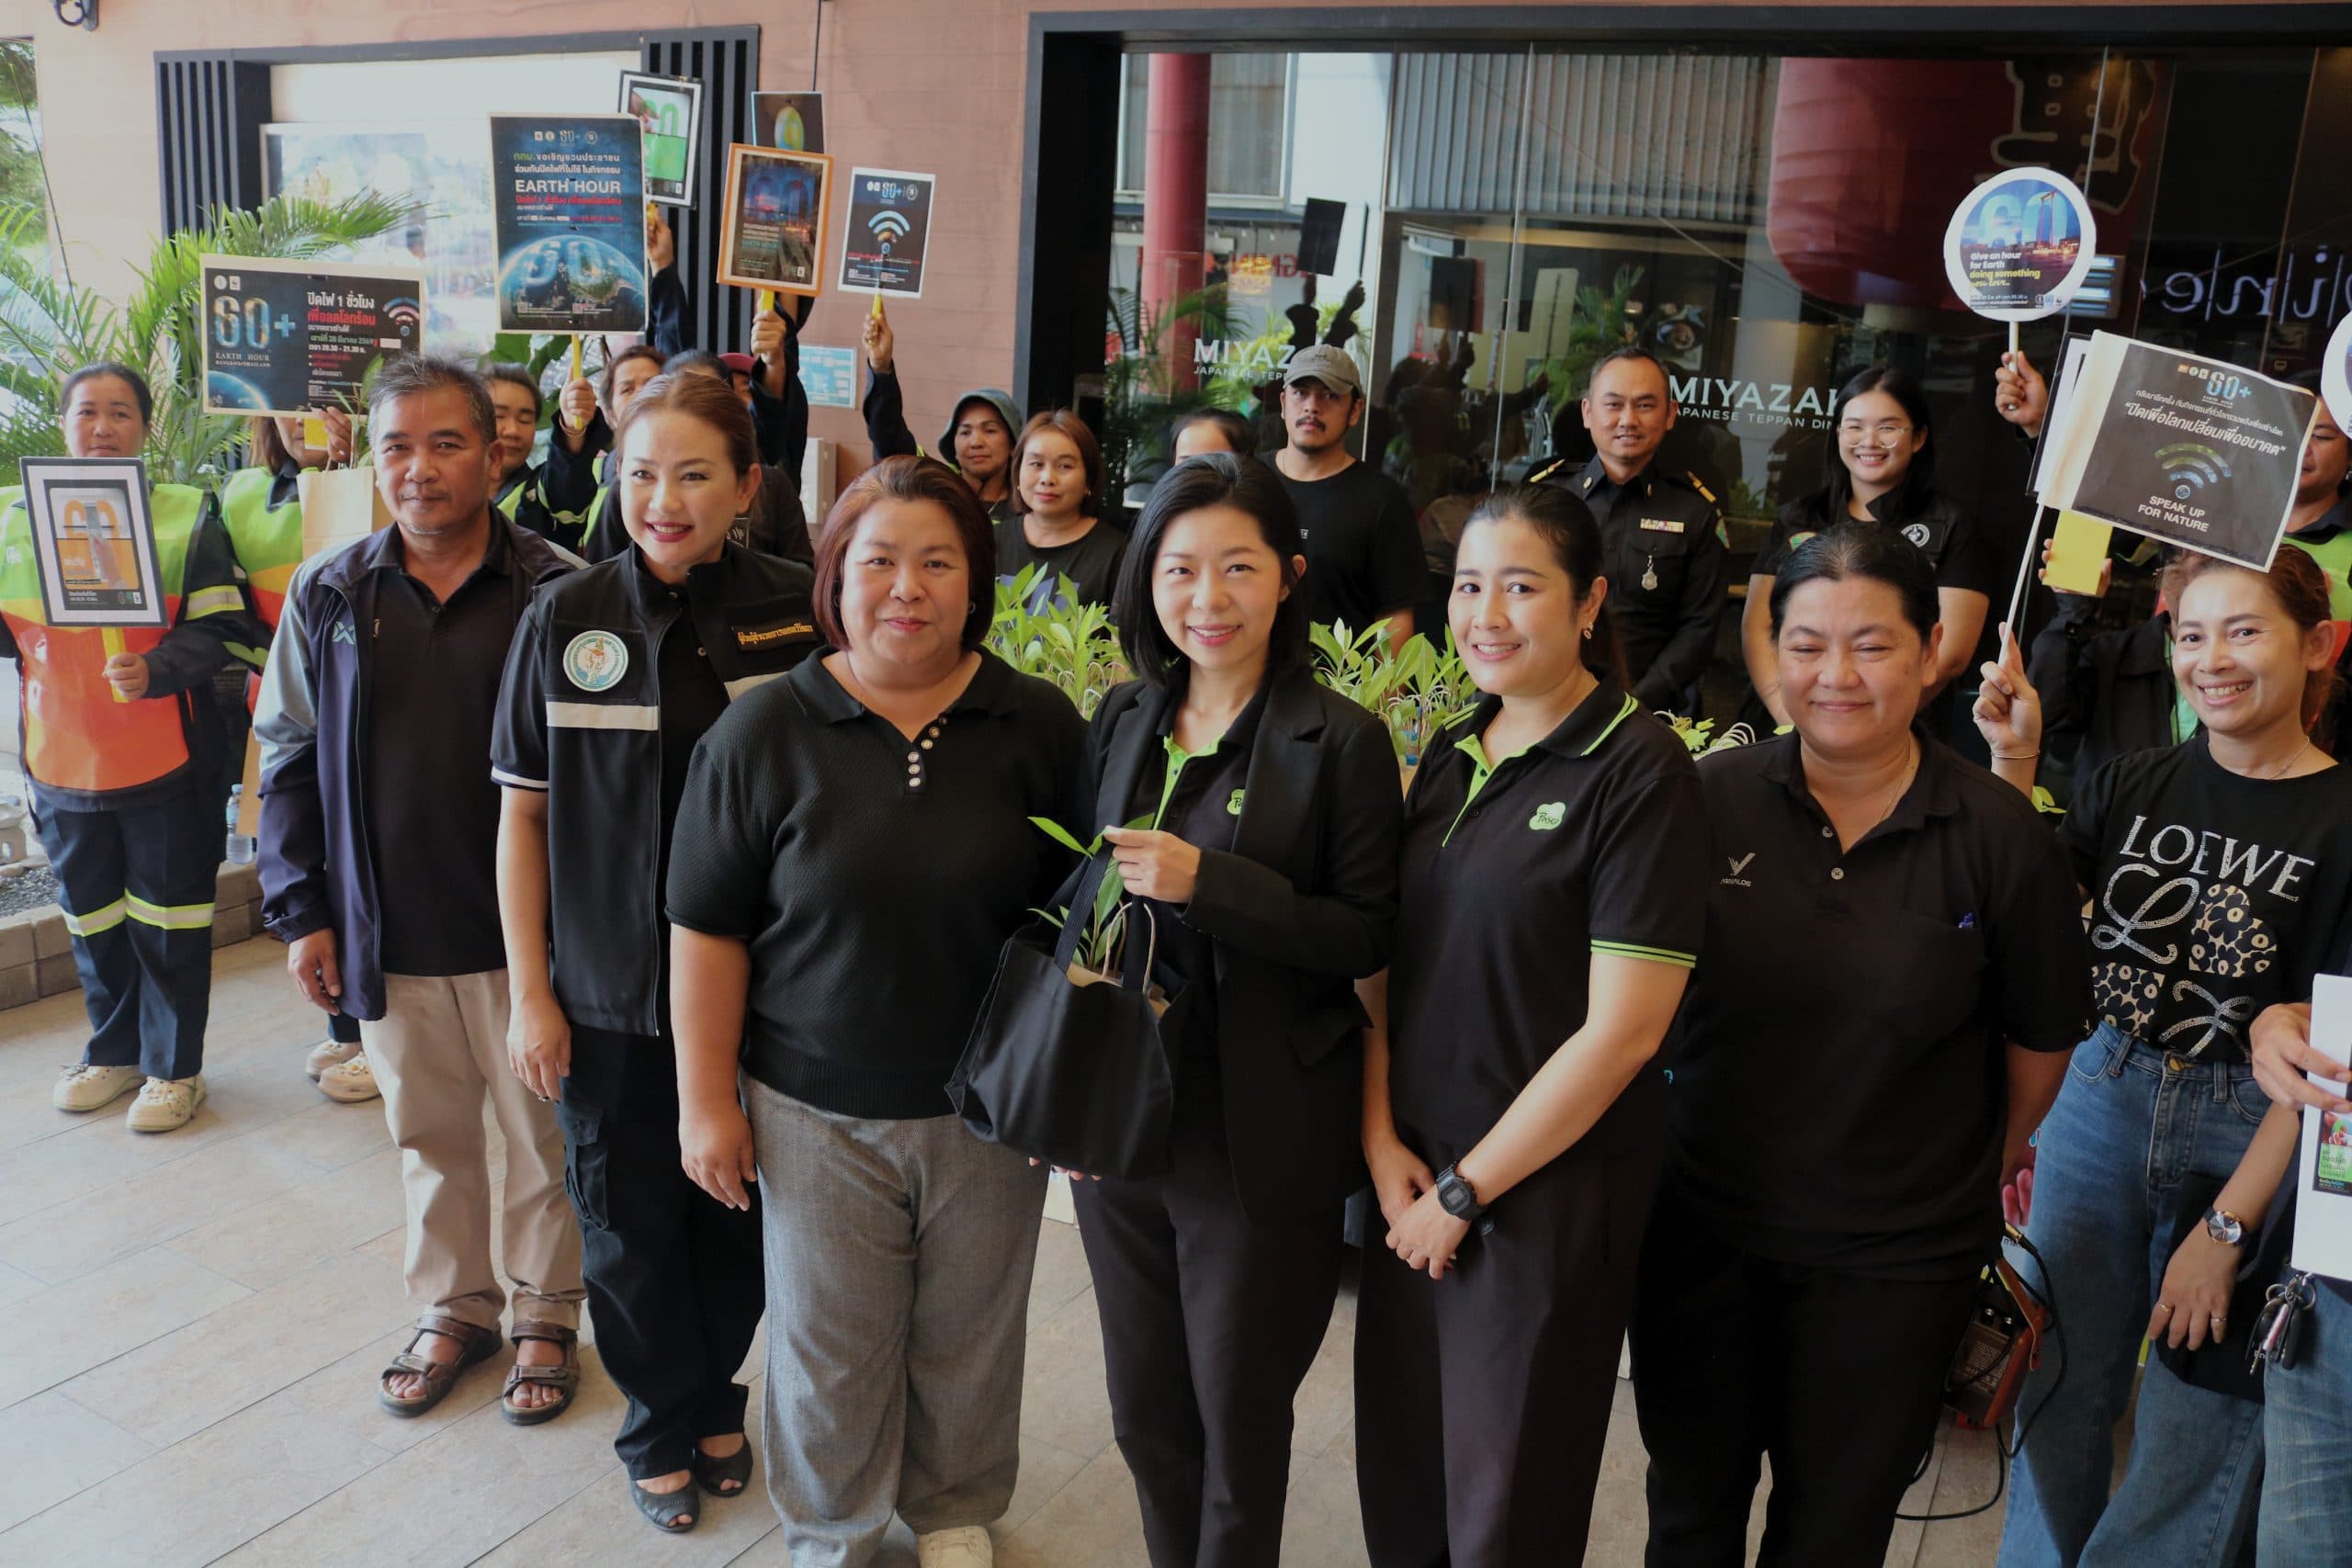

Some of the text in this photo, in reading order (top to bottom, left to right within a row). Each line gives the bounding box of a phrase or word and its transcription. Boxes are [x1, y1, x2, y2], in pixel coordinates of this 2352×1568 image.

[514, 179, 621, 193] EARTH HOUR
[1970, 251, 1988, 260] Give
[2001, 251, 2021, 259] hour
[1970, 261, 2005, 269] for Earth
[1970, 268, 2041, 279] doing something
[307, 289, 375, 309] ปิดไฟ 1 ชั่วโมง
[213, 295, 296, 350] 60+
[308, 308, 376, 326] เพื่อลดโลกร้อน
[215, 352, 270, 362] EARTH HOUR
[1193, 338, 1295, 369] MIYAZ
[2206, 370, 2251, 400] 60+
[1675, 406, 1833, 430] APANESE TEPPAN DIN
[2149, 495, 2205, 518] SPEAK UP
[2138, 503, 2210, 533] FOR NATURE
[2120, 815, 2315, 902] LOEWE
